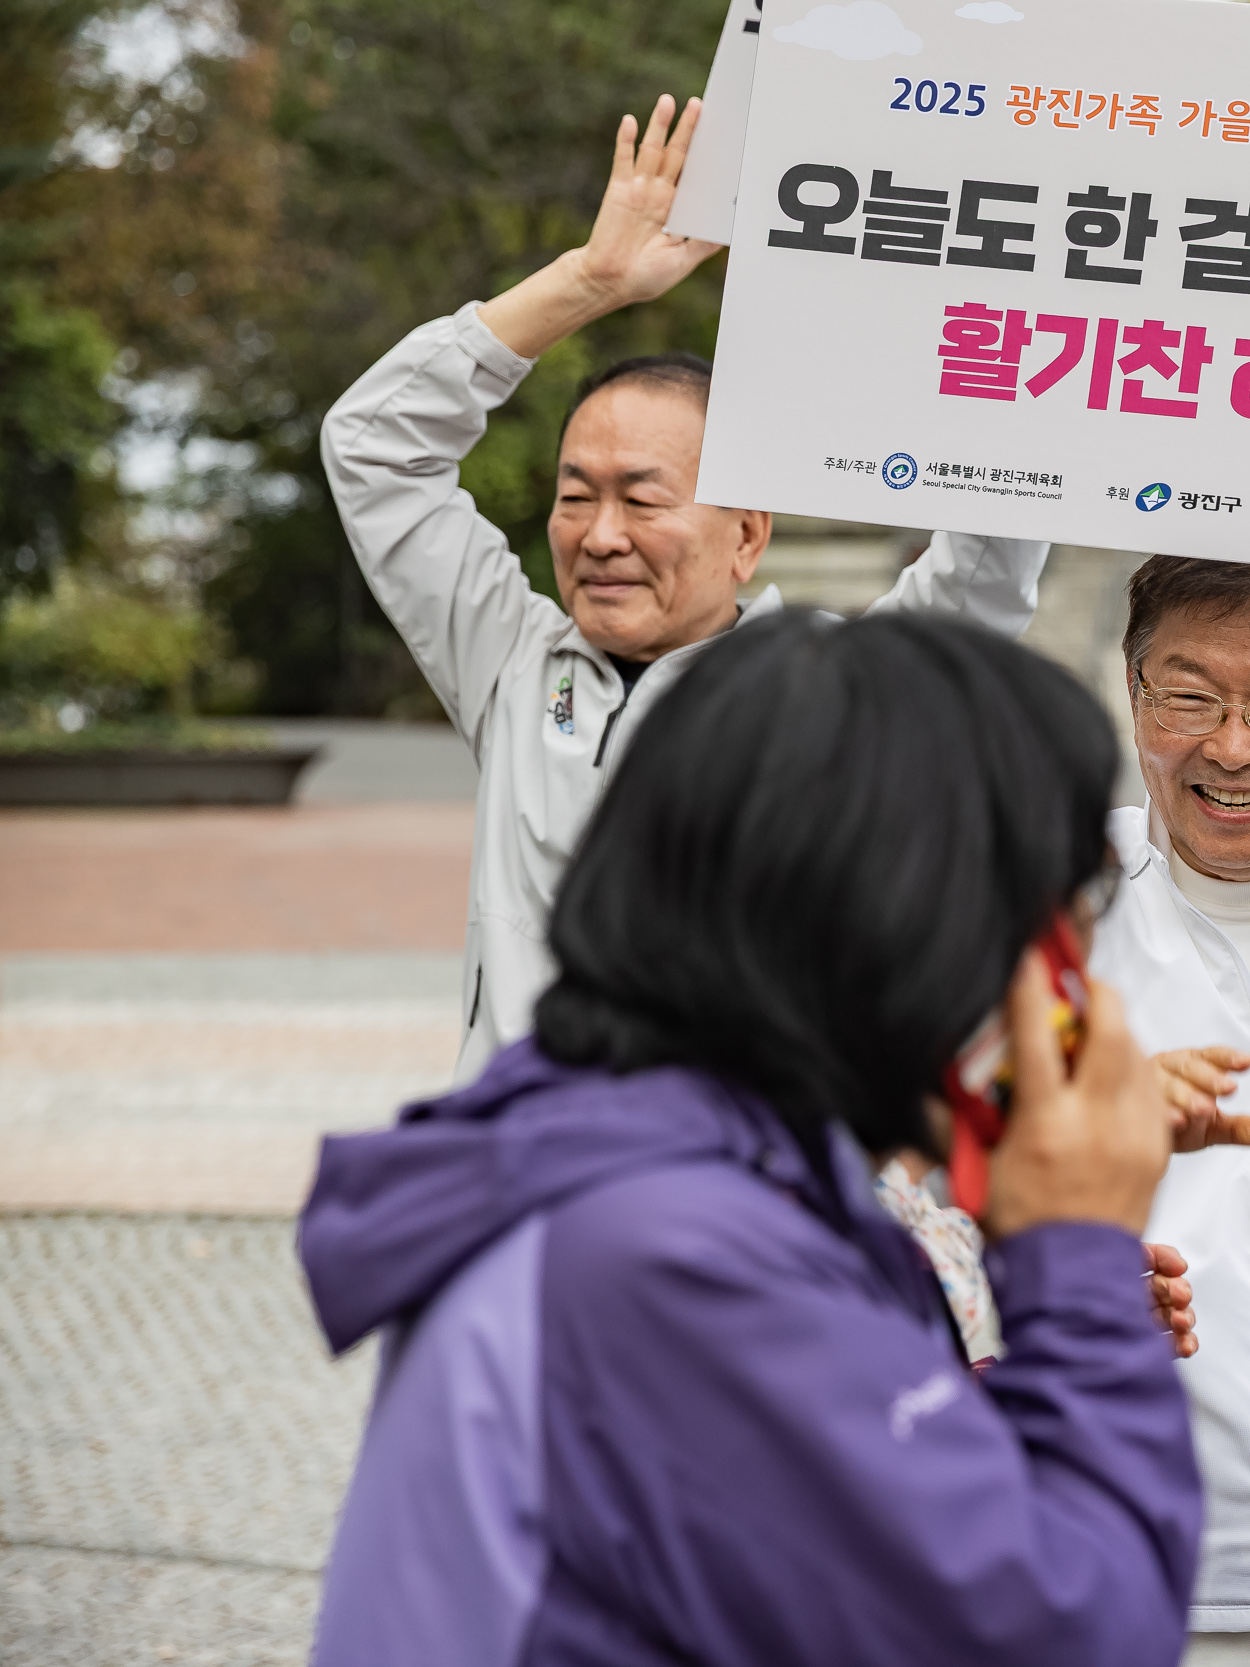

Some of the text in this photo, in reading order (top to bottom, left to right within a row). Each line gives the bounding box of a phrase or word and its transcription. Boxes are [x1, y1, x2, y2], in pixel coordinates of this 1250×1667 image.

[890, 77, 987, 117] 2025
[1006, 85, 1163, 136] 광진가족
[767, 163, 1040, 273] 오늘도
[1064, 185, 1158, 285] 한
[937, 301, 1214, 419] 활기찬
[823, 457, 1063, 489] 주최/주관 서울특별시 광진구체육회
[922, 479, 941, 488] Seoul
[942, 481, 966, 490] Special
[967, 484, 981, 493] City
[981, 486, 1013, 496] Gwangjin
[1014, 489, 1036, 498] Sports
[1037, 491, 1063, 500] Council
[1106, 486, 1243, 514] 후원 광진구
